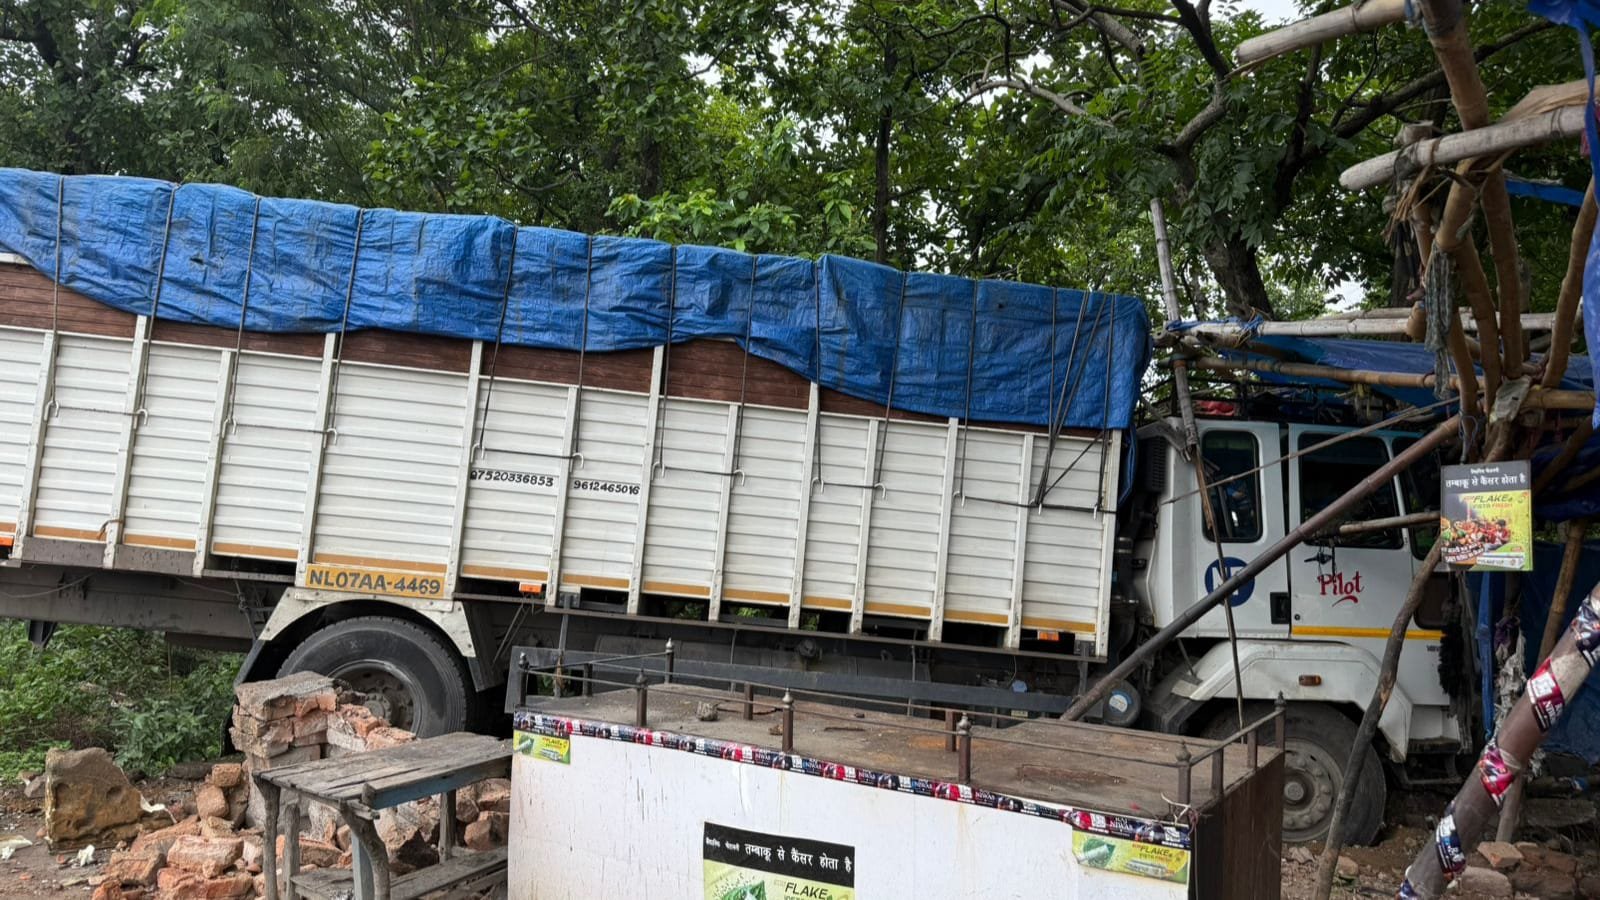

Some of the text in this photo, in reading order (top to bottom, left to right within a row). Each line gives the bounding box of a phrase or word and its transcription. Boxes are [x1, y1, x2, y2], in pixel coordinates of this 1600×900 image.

[478, 470, 640, 495] 7520336853 9612465016
[309, 569, 441, 595] NL07AA-4469
[1316, 570, 1365, 595] Pilot
[744, 843, 771, 862] तम्बाकू
[777, 845, 785, 861] से
[819, 851, 839, 870] होता
[844, 855, 852, 873] है
[785, 882, 829, 900] FLAKE
